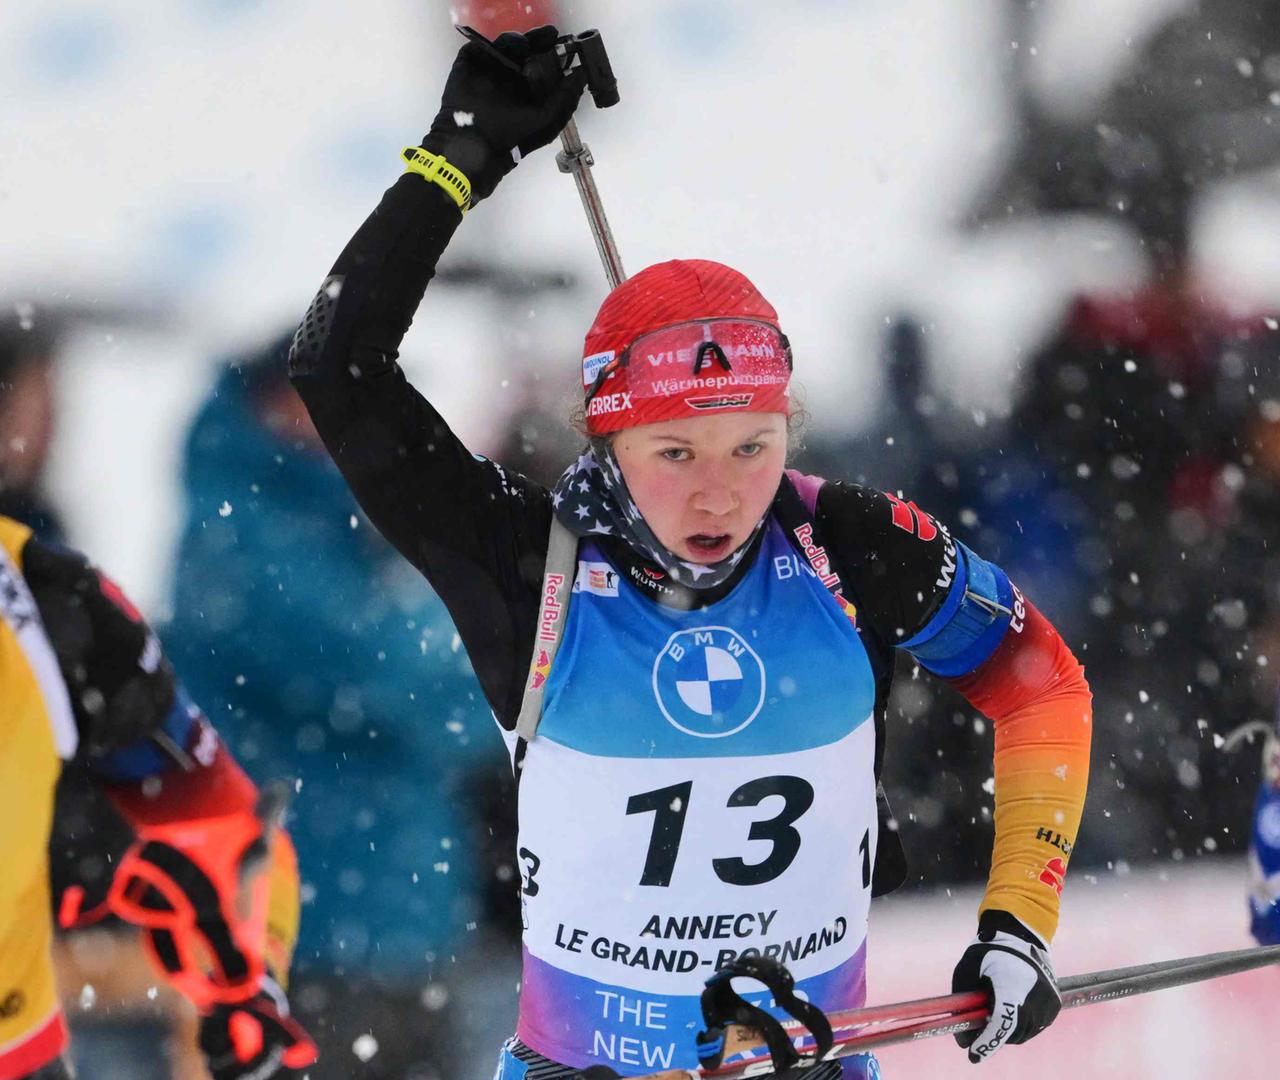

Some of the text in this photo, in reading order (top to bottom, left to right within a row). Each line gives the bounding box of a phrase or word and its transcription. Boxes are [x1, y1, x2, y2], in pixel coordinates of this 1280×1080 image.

[630, 566, 674, 595] WÜRTH
[625, 775, 815, 888] 13
[554, 923, 589, 953] LE
[639, 910, 778, 940] ANNECY
[593, 990, 668, 1030] THE
[592, 1030, 676, 1069] NEW
